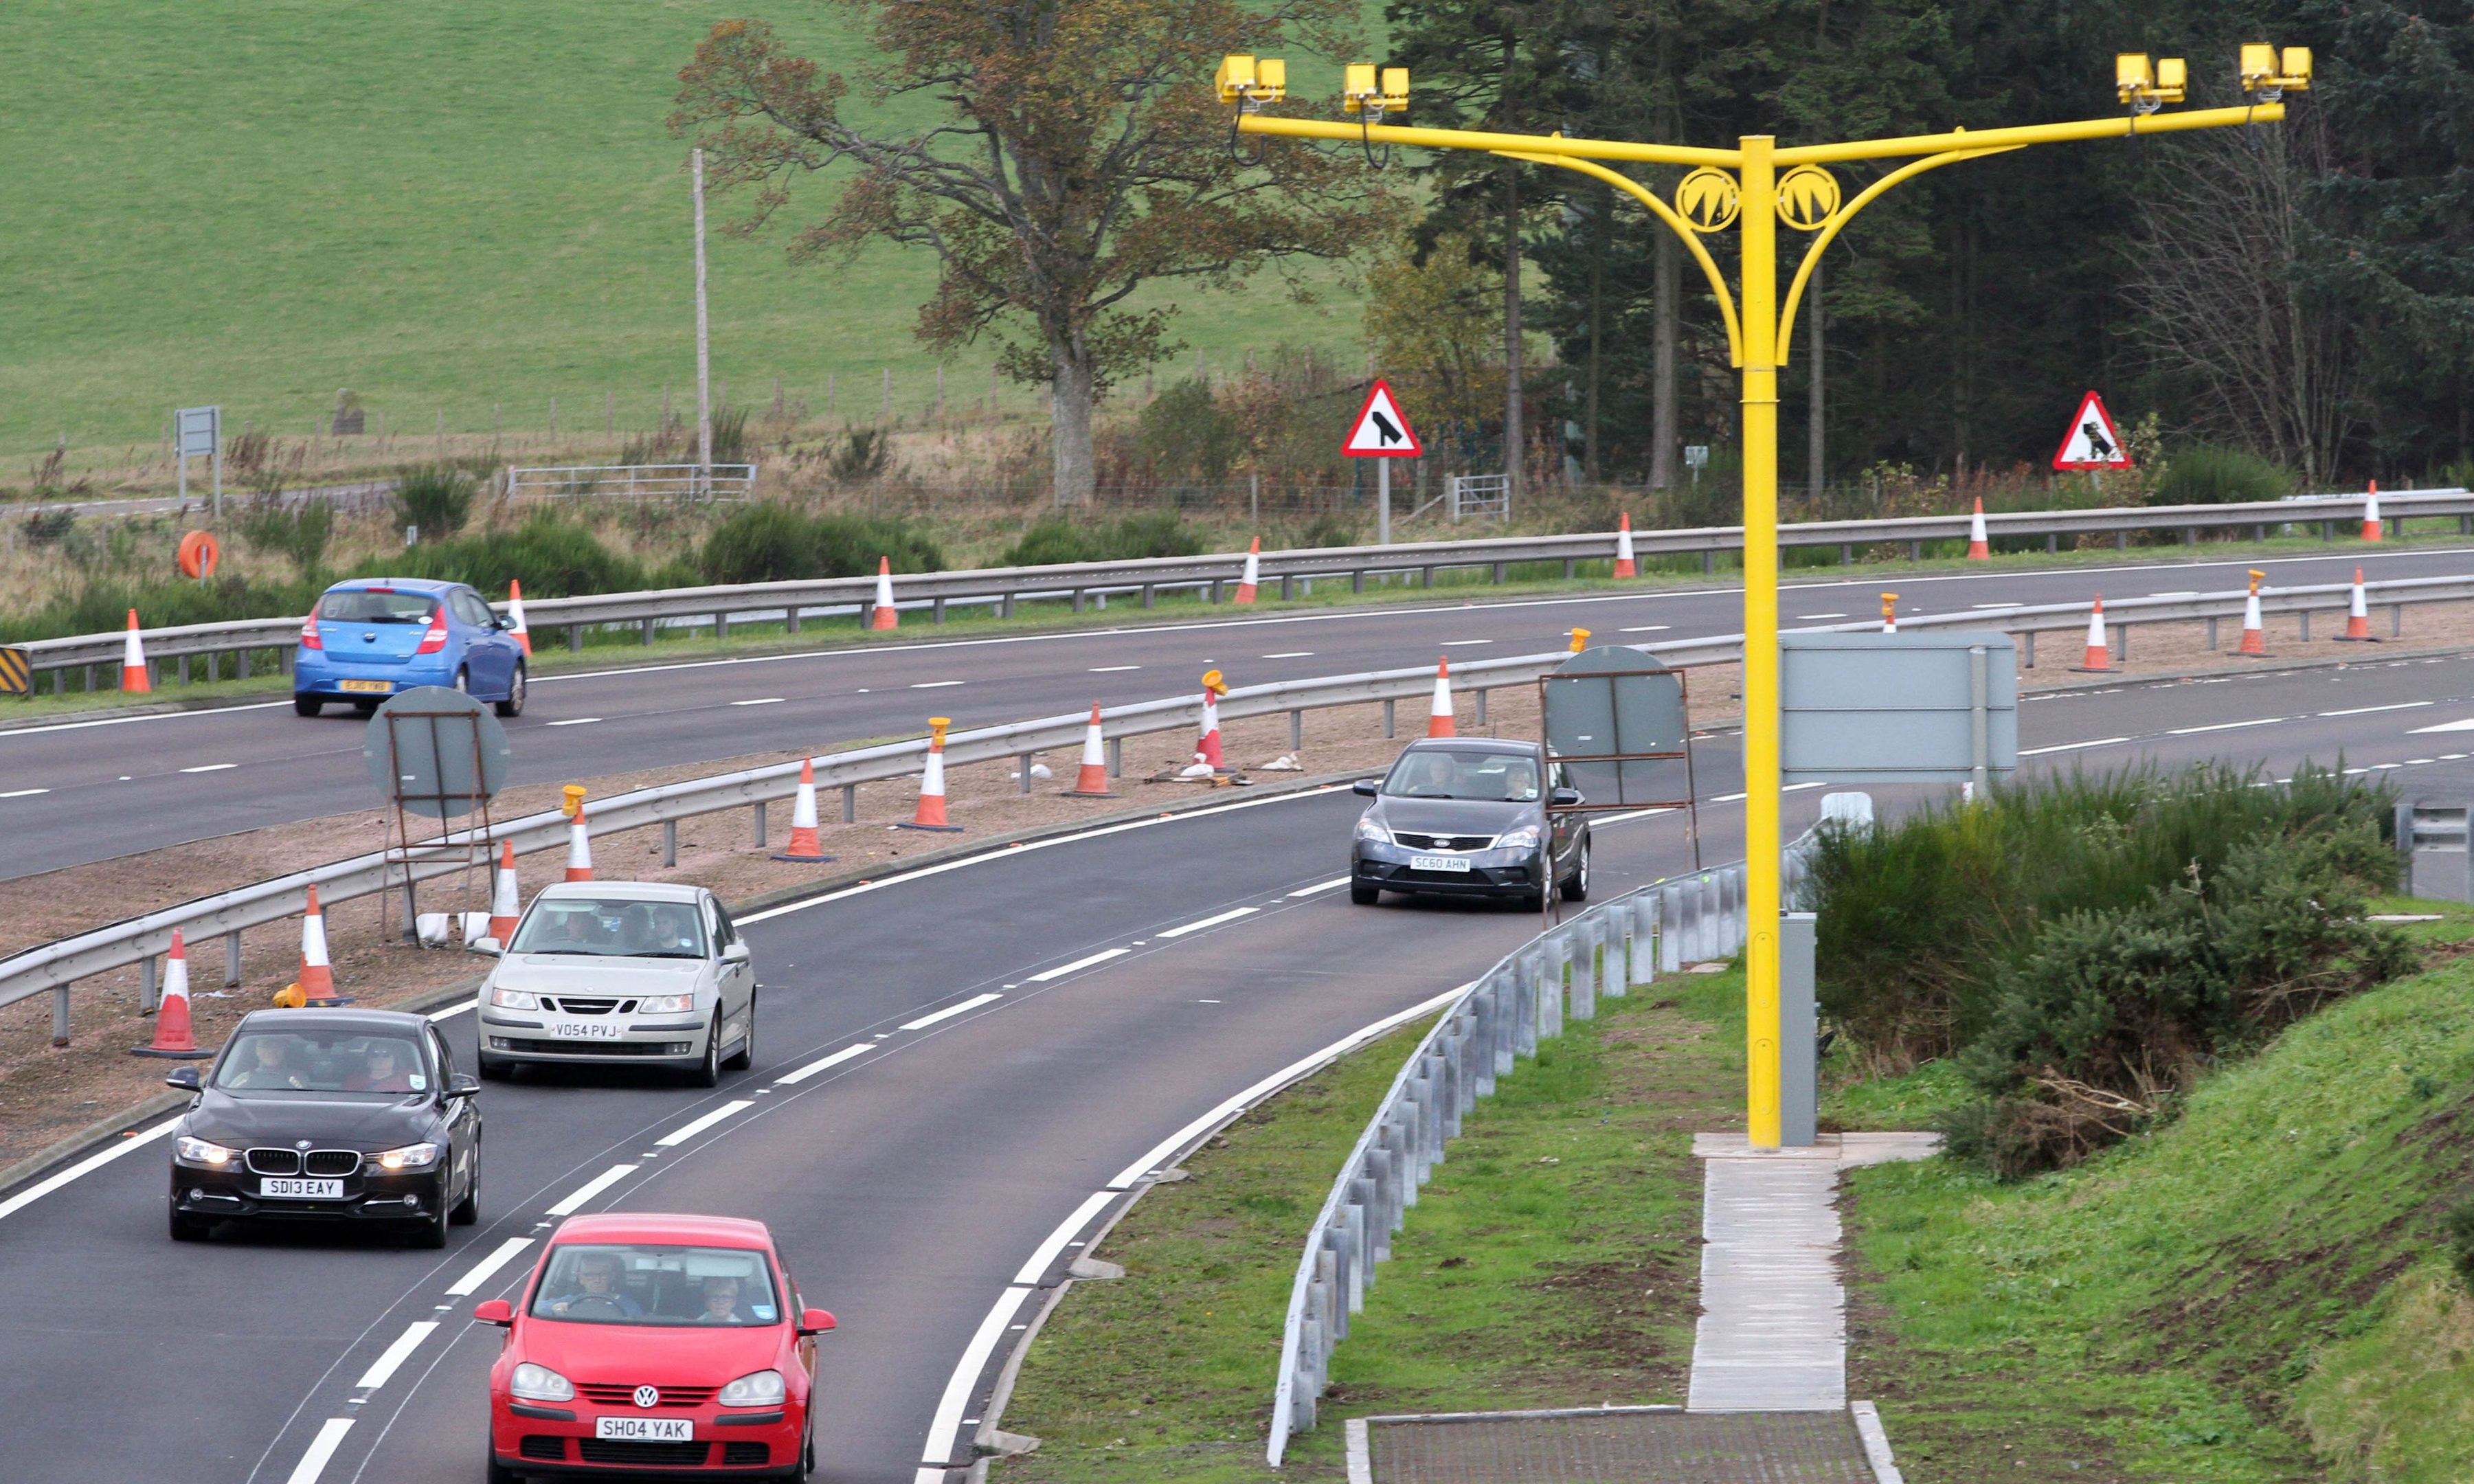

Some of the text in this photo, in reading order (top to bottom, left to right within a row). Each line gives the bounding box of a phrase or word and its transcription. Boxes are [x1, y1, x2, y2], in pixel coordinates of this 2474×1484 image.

[1415, 857, 1466, 869] SC60 AHN
[556, 1024, 616, 1037] VO54 PVJ
[271, 1180, 334, 1194] SD13 EAY
[635, 1386, 657, 1406] VW
[604, 1420, 685, 1437] SH04 YAK
